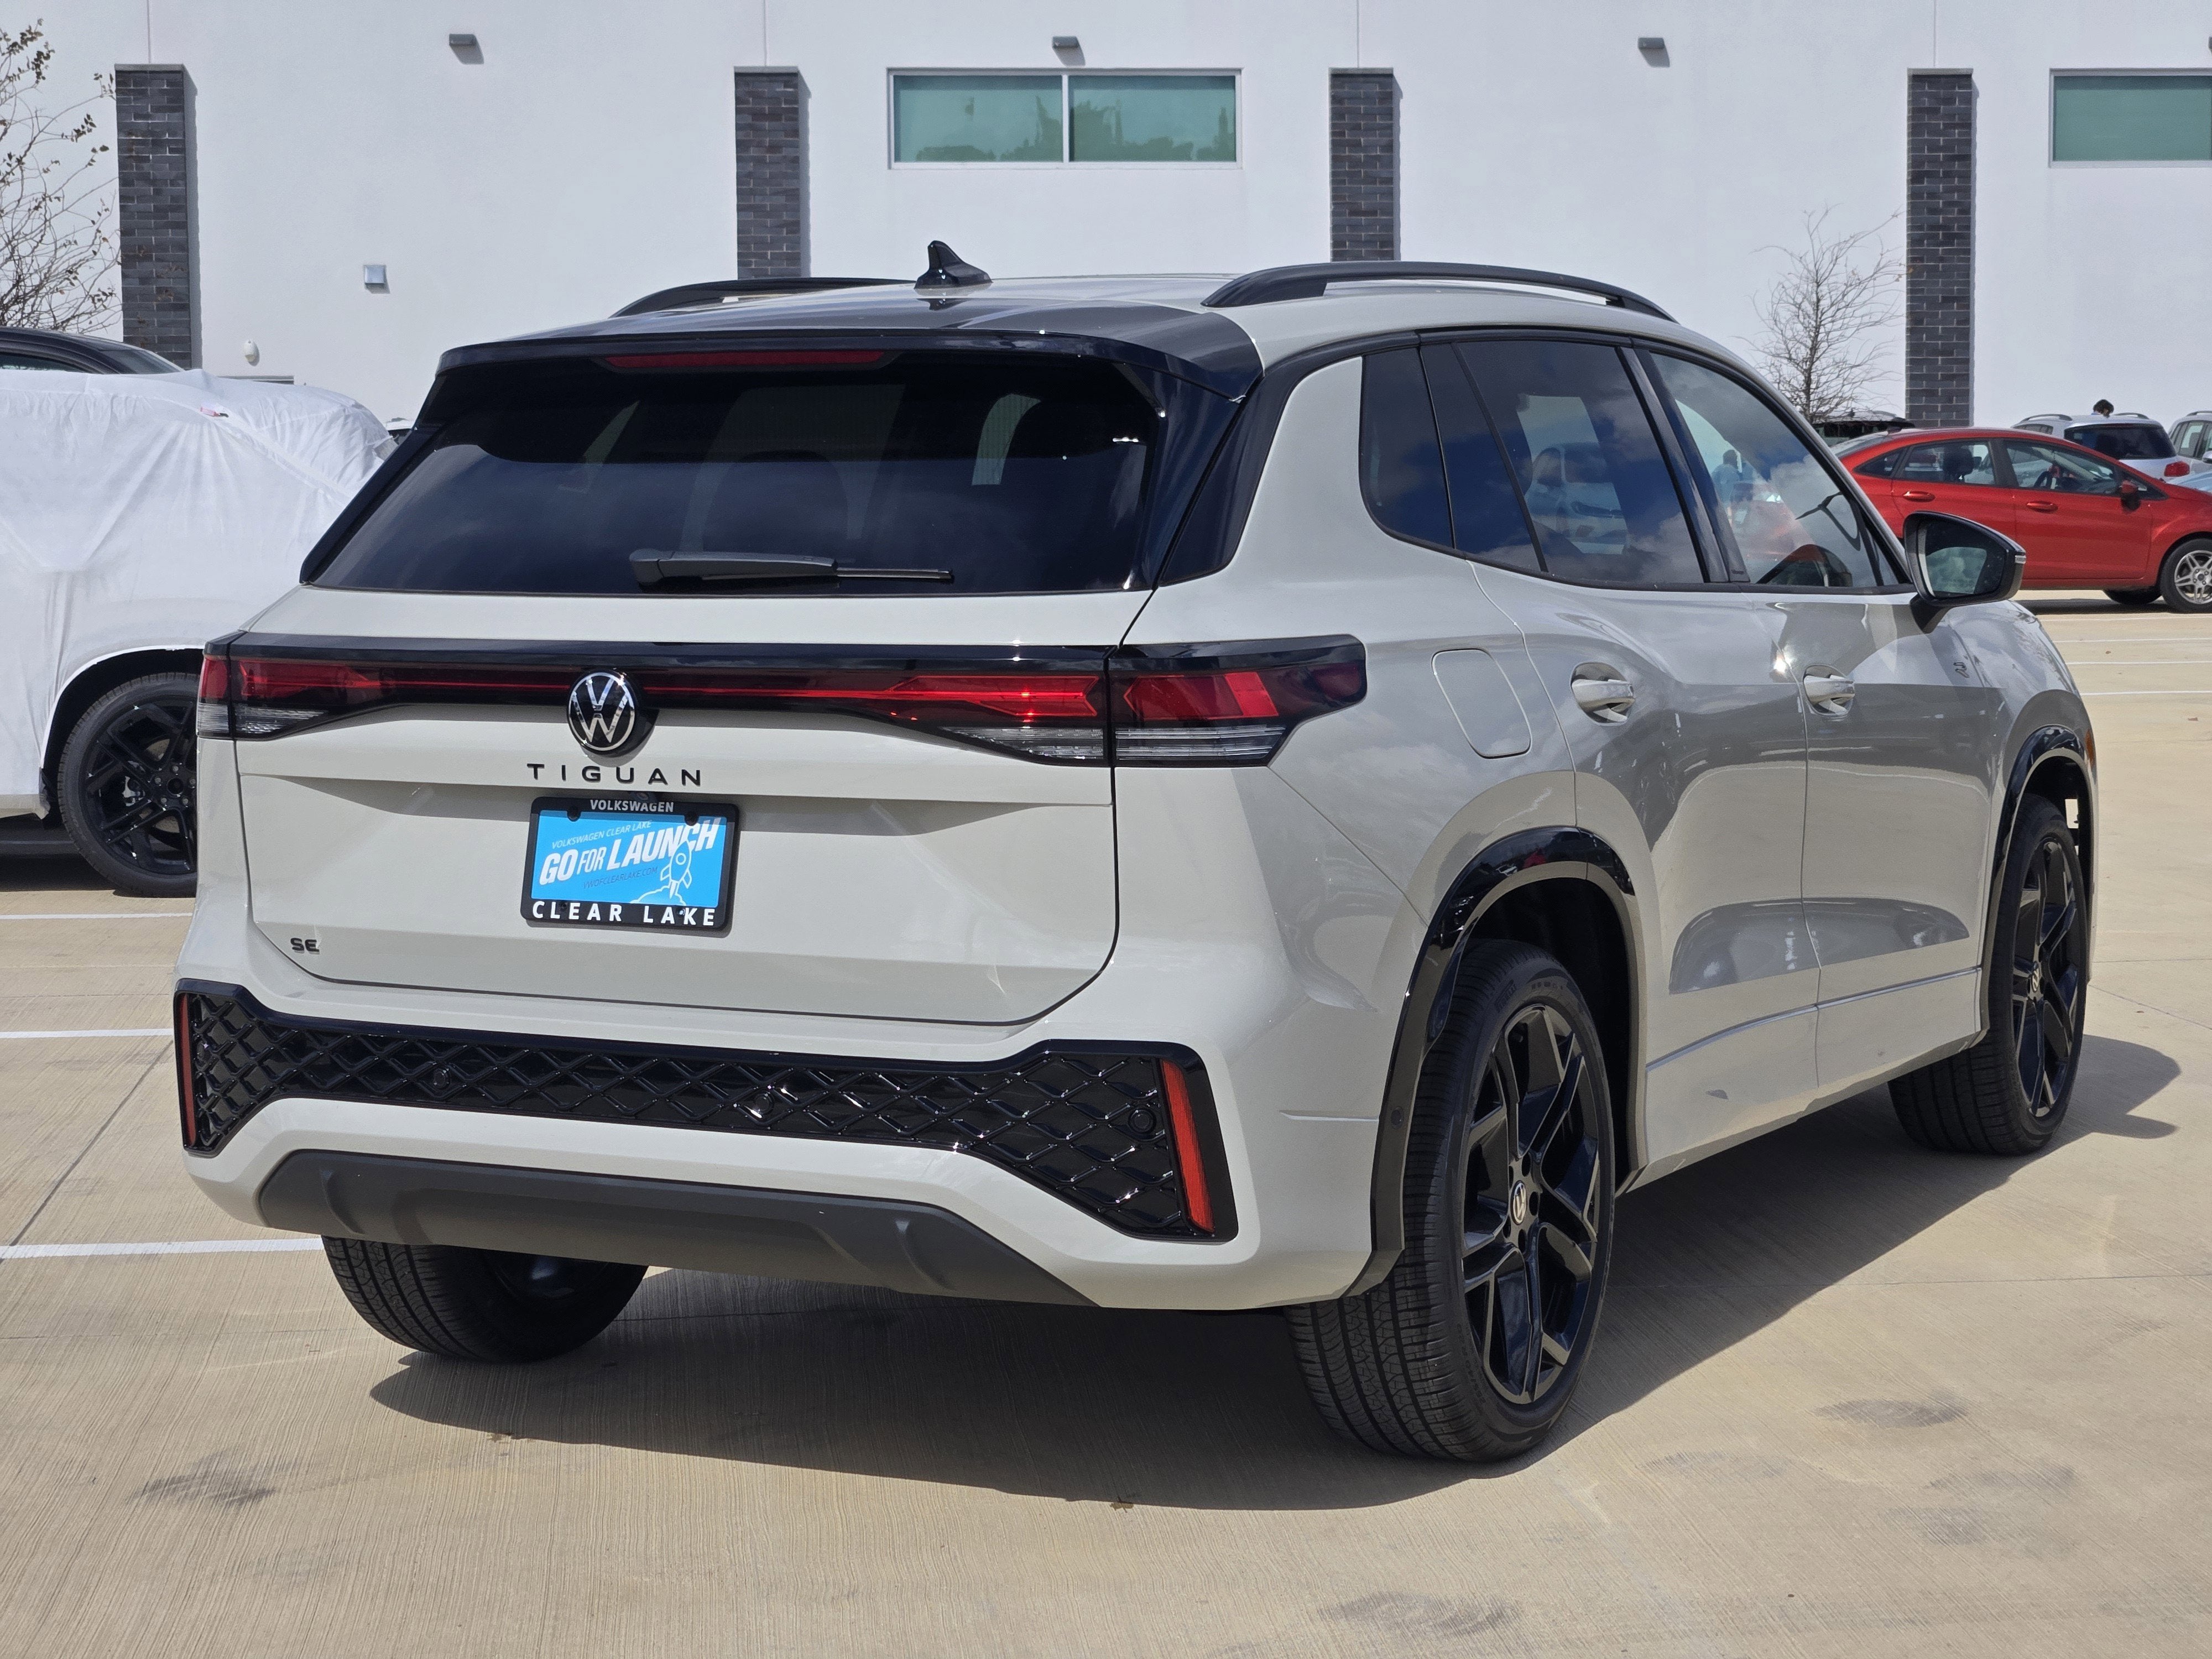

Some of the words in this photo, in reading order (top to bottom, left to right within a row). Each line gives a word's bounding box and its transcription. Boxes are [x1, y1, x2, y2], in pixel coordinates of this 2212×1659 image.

[527, 763, 701, 786] TIGUAN
[590, 800, 674, 812] VOLKSWAGEN
[553, 832, 604, 848] VOLKSWAGEN
[607, 824, 630, 837] CLEAR
[633, 820, 652, 831] LAKE
[539, 849, 578, 885] GO
[577, 847, 607, 875] FOR
[607, 818, 721, 869] LAUNCH
[583, 867, 658, 889] VWOFCLEARLAKE.COM
[533, 901, 623, 922] CLEAR
[643, 905, 716, 926] LAKE
[290, 937, 320, 953] SE
